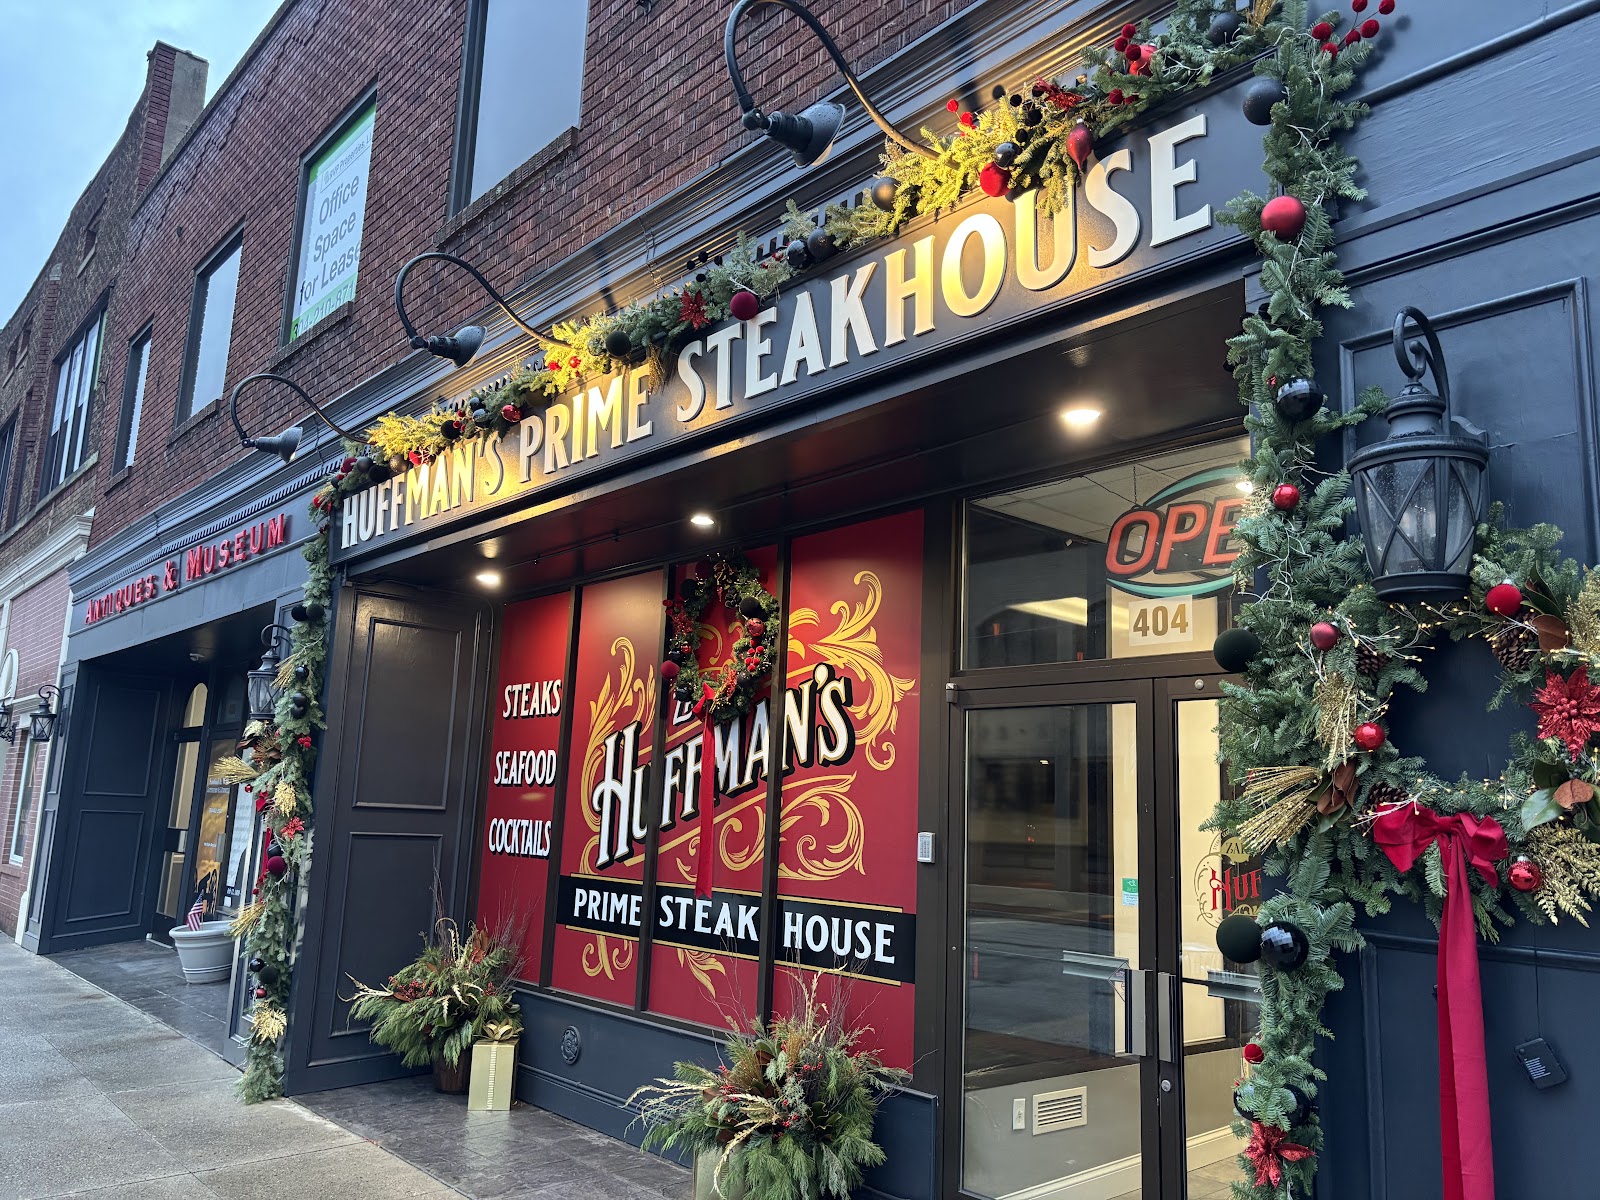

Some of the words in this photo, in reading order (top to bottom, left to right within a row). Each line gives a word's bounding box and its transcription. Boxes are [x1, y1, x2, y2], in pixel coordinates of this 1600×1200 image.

[319, 175, 360, 225] Office
[313, 211, 356, 263] Space
[299, 274, 319, 306] for
[321, 240, 361, 290] Lease
[341, 434, 504, 549] HUFFMAN'S
[519, 363, 654, 483] PRIME
[676, 113, 1212, 422] STEAKHOUSE
[1105, 496, 1248, 575] OPE
[84, 574, 157, 625] ANTIQUES
[163, 560, 178, 592] &
[186, 512, 286, 582] MUSEUM
[1132, 603, 1189, 637] 404
[503, 679, 562, 720] STEAKS
[494, 749, 557, 787] SEAFOOD
[488, 818, 552, 858] COCKTAILS
[573, 887, 643, 928] PRIME
[659, 894, 760, 943] STEAK
[783, 910, 896, 965] HOUSE
